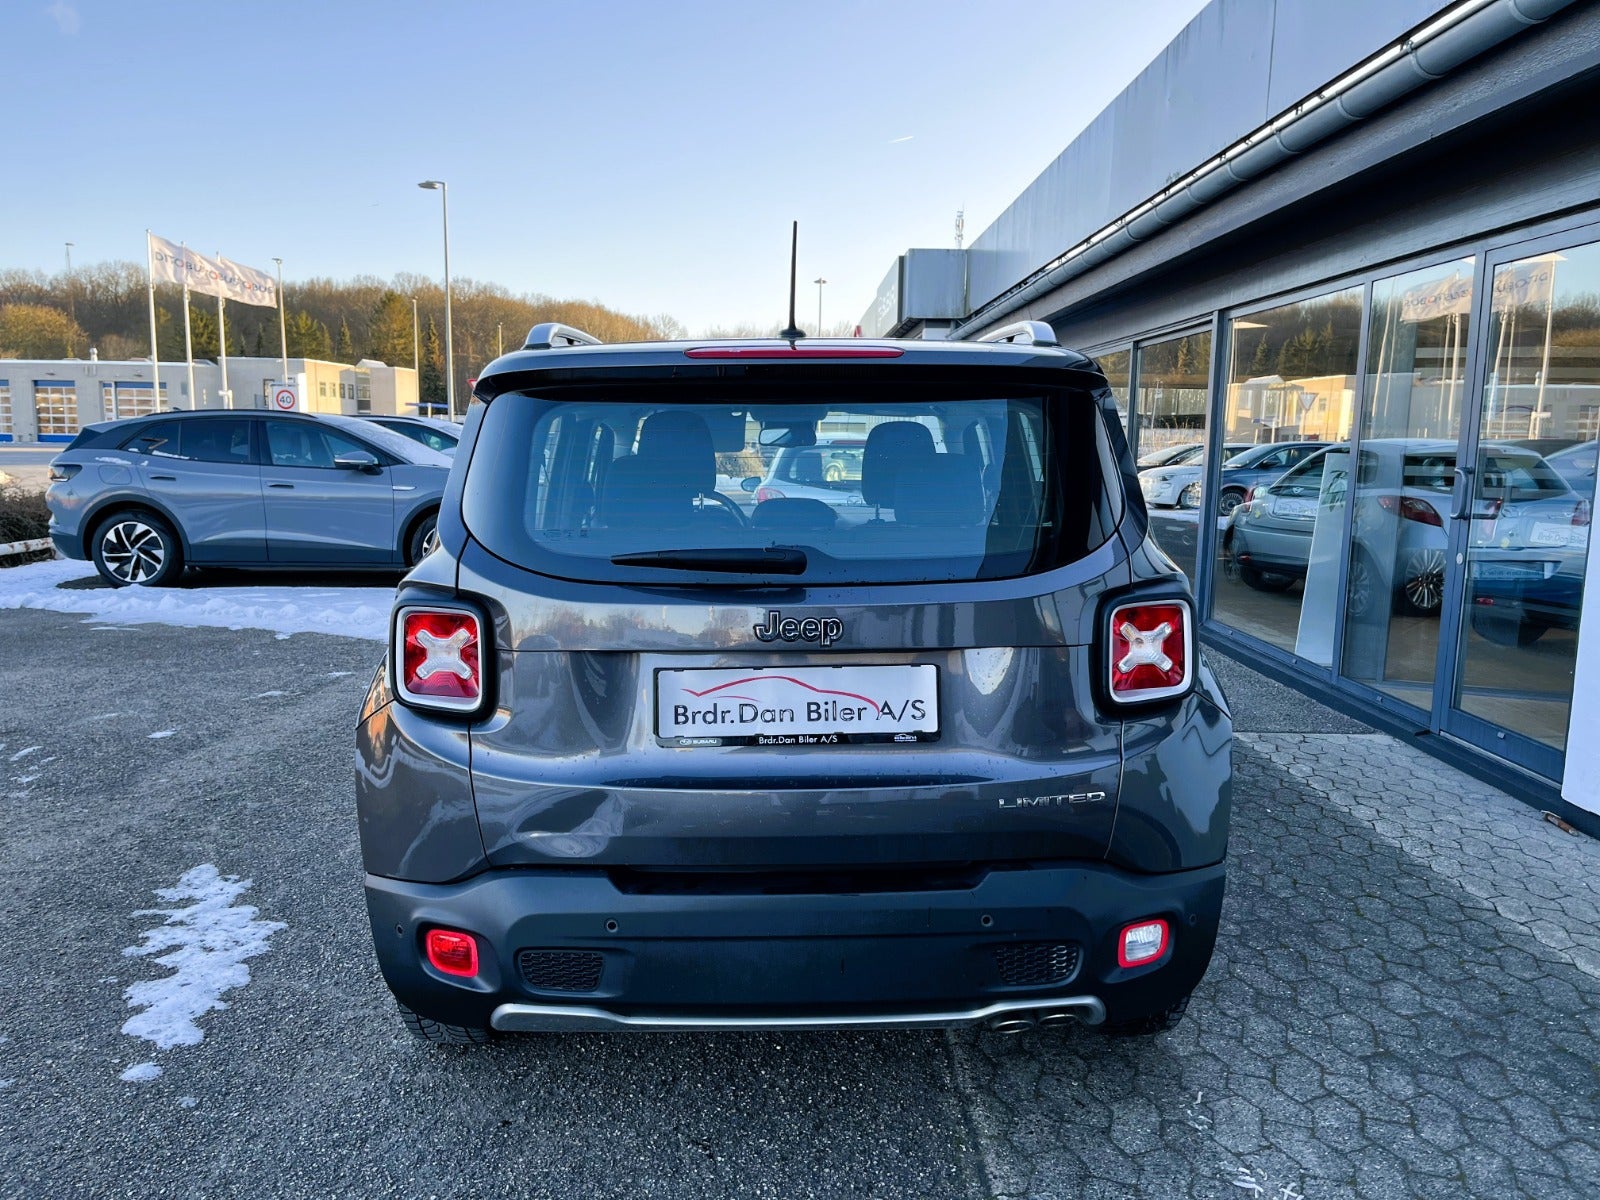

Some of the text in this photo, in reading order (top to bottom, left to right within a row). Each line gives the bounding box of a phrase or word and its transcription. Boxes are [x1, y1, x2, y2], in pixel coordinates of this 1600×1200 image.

[280, 395, 292, 404] 40
[753, 610, 843, 646] Jeep
[806, 700, 867, 722] Biler
[876, 700, 926, 722] A/S
[798, 735, 818, 743] Biler
[820, 735, 838, 744] A/S
[999, 791, 1105, 808] LIMITED
